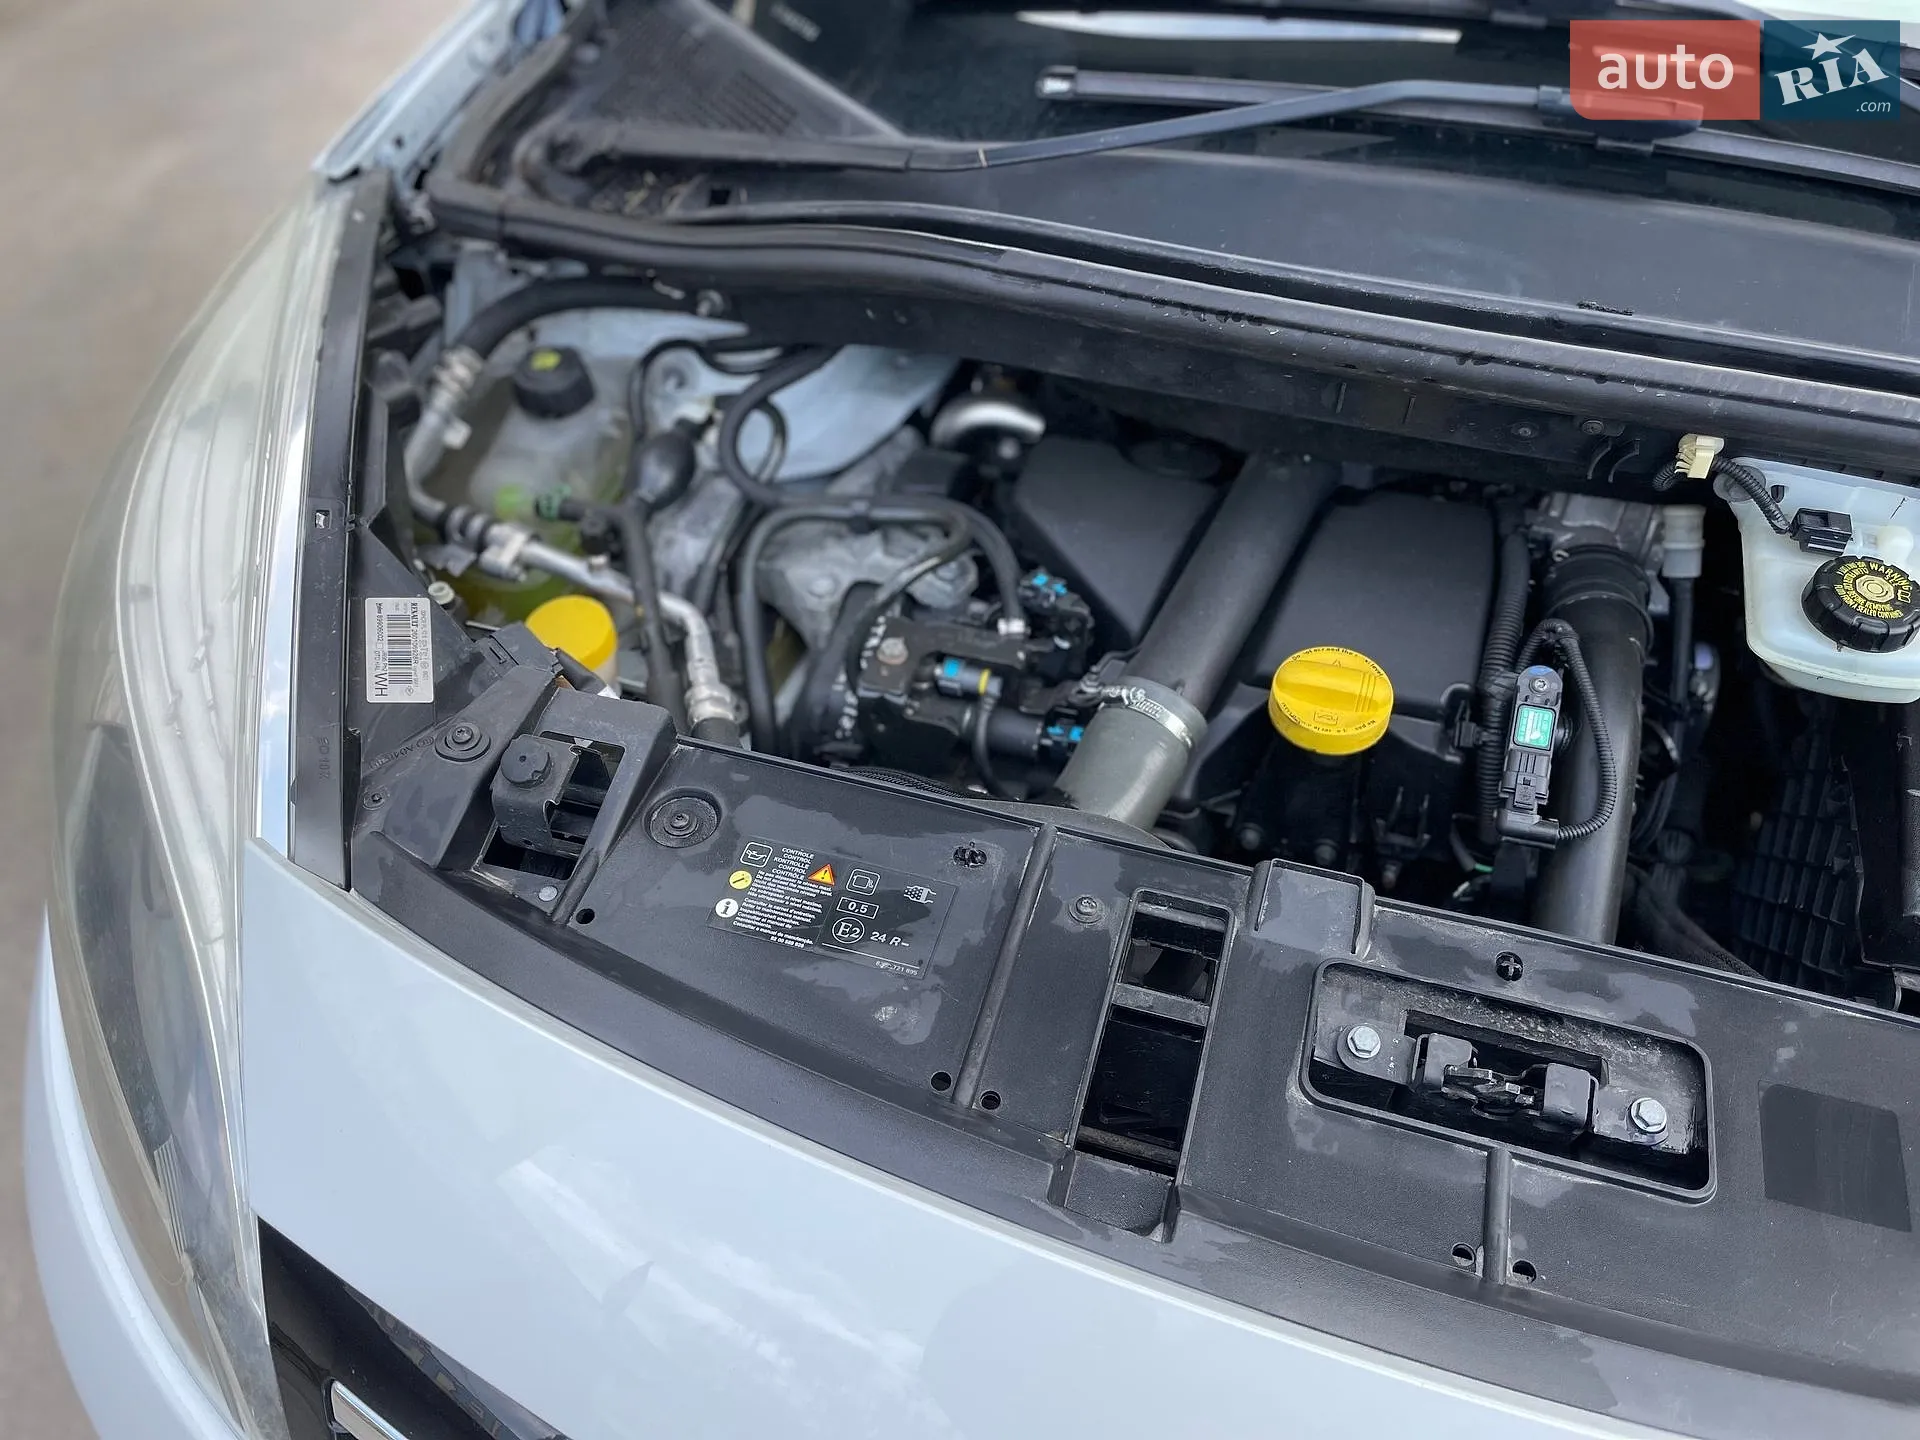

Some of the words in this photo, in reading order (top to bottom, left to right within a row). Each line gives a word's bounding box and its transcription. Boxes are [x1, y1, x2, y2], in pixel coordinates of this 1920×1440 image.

[1869, 563, 1912, 590] WARNING
[375, 673, 388, 697] WH
[773, 856, 809, 868] KONTROLLE
[782, 853, 812, 863] CONTROL
[777, 863, 807, 874] CONTROL
[848, 902, 868, 913] 0,5
[836, 921, 861, 938] E2
[870, 931, 887, 942] 24
